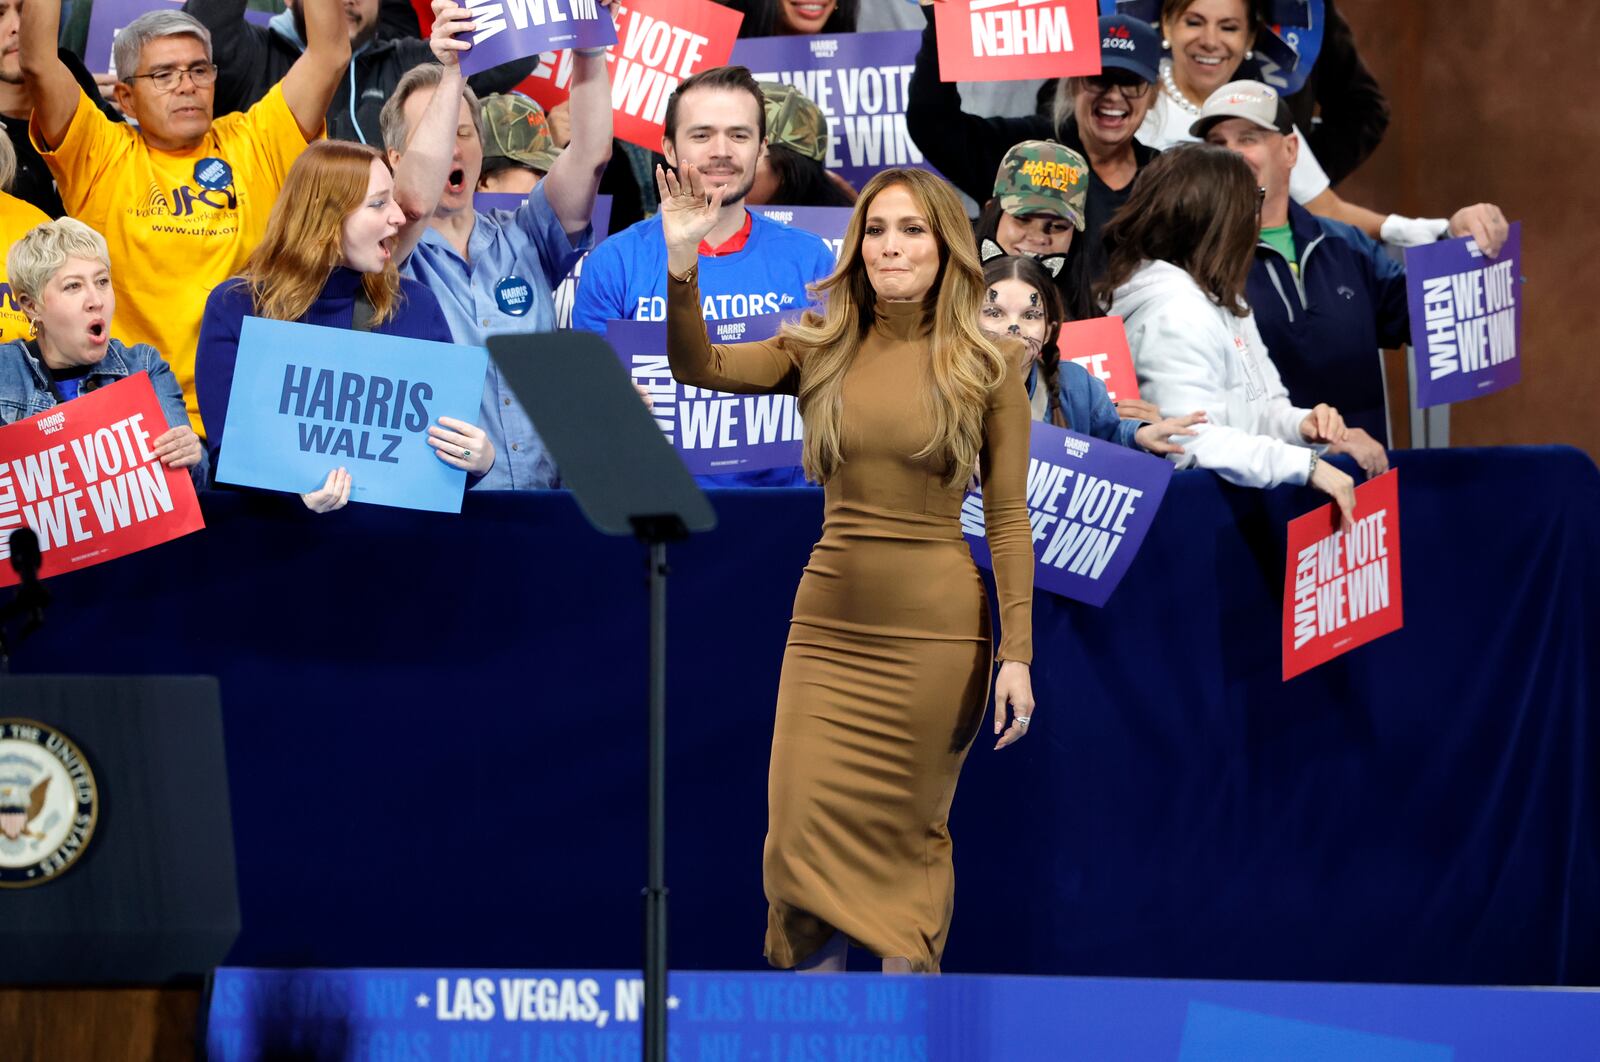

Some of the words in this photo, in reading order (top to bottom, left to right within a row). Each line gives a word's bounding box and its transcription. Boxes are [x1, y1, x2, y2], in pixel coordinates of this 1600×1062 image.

[623, 10, 709, 80] VOTE
[970, 6, 1074, 57] WHEN
[1102, 37, 1136, 51] 2024
[1021, 160, 1079, 185] HARRIS
[1031, 173, 1068, 192] WALZ
[501, 285, 528, 301] HARRIS
[507, 296, 526, 306] WALZ
[1451, 268, 1485, 321] WE
[1483, 258, 1515, 314] VOTE
[717, 322, 746, 335] HARRIS
[721, 333, 742, 341] WALZ
[1423, 275, 1459, 381] WHEN
[1456, 316, 1490, 374] WE
[1487, 307, 1516, 366] WIN
[37, 411, 66, 431] HARRIS
[279, 364, 433, 433] HARRIS
[679, 398, 740, 449] WE
[43, 423, 64, 436] WALZ
[298, 422, 403, 464] WALZ
[1064, 436, 1090, 454] HARRIS
[12, 444, 75, 503] WE
[70, 412, 158, 484] VOTE
[22, 489, 93, 553] WE
[86, 461, 174, 534] WIN
[1027, 458, 1074, 514] WE
[1065, 472, 1143, 534] VOTE
[1040, 518, 1123, 581] WIN
[1317, 530, 1344, 585] WE
[1344, 508, 1388, 571] VOTE
[1294, 542, 1319, 650] WHEN
[1315, 575, 1347, 637] WE
[1346, 557, 1390, 623] WIN
[10, 725, 40, 744] THE
[46, 733, 92, 804] UNITED
[436, 977, 495, 1021] LAS
[501, 977, 609, 1028] VEGAS,
[688, 980, 744, 1022] LAS
